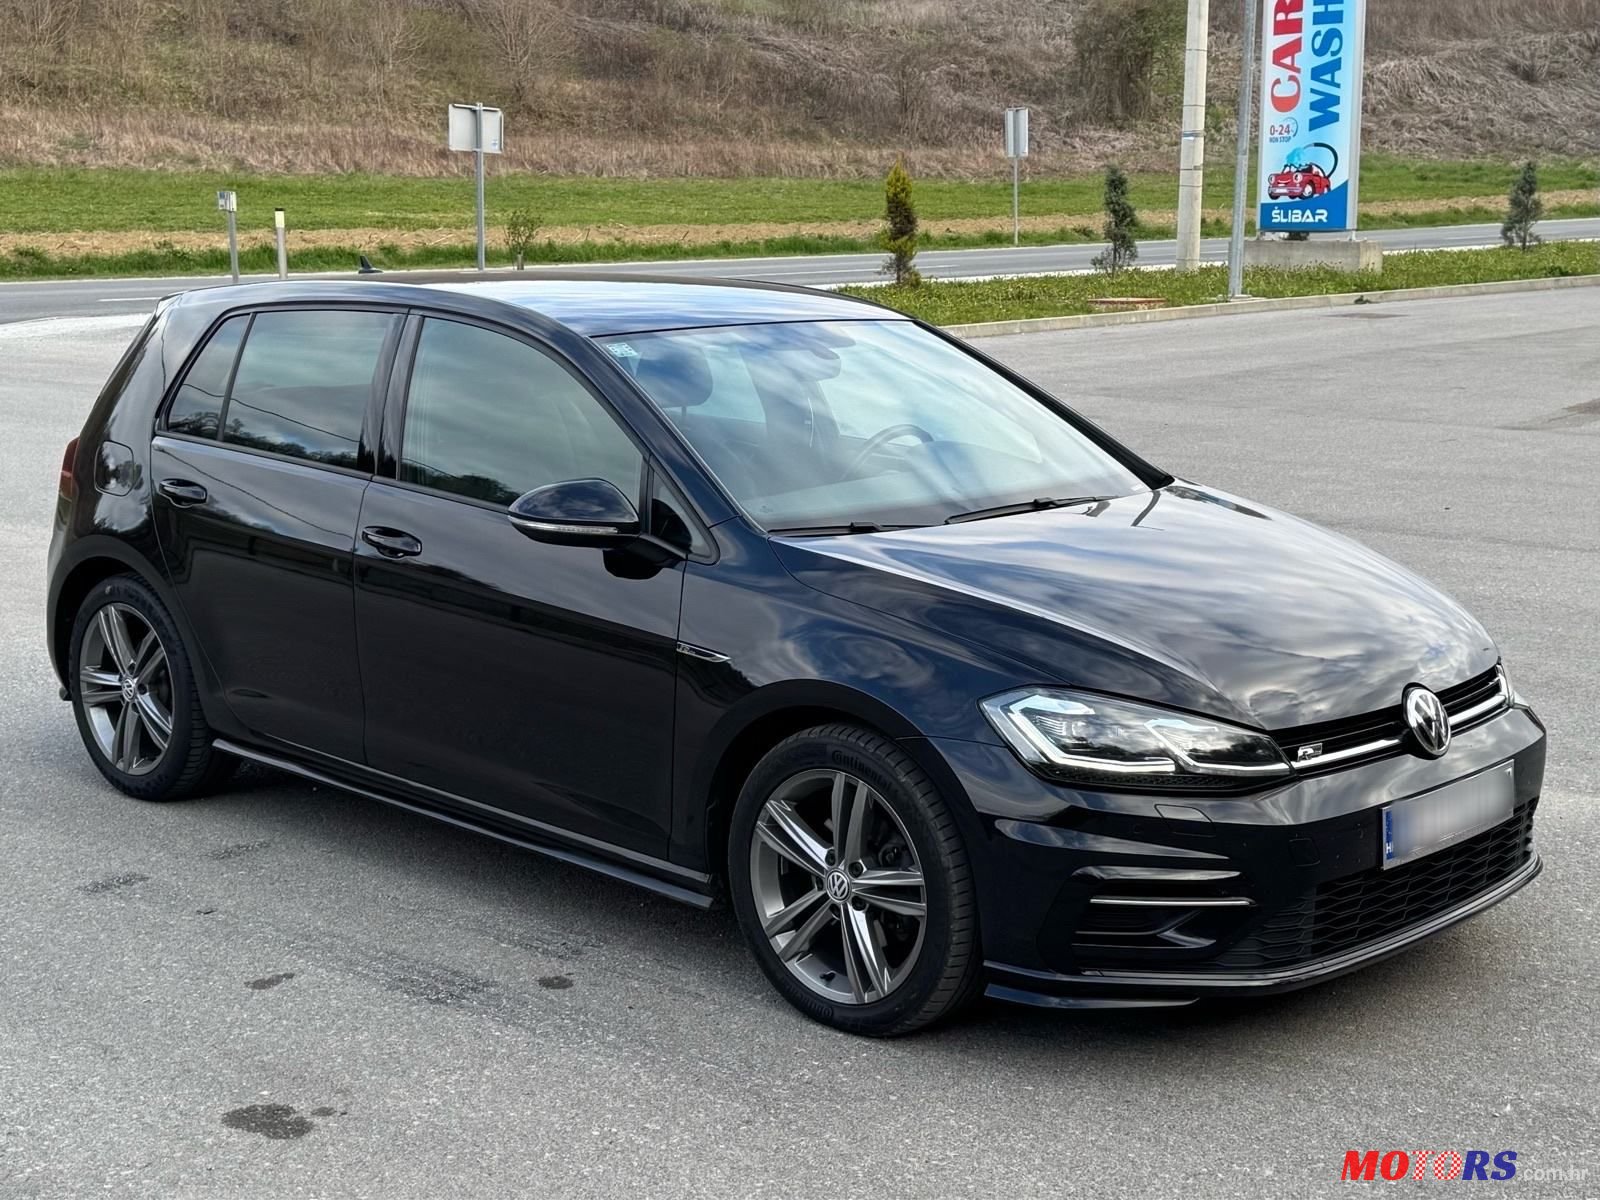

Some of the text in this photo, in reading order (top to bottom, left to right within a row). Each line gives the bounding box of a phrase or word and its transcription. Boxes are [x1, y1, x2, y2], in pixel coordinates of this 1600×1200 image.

[1271, 0, 1304, 113] CAR
[1308, 0, 1344, 132] WASH
[1269, 124, 1291, 136] 0-24
